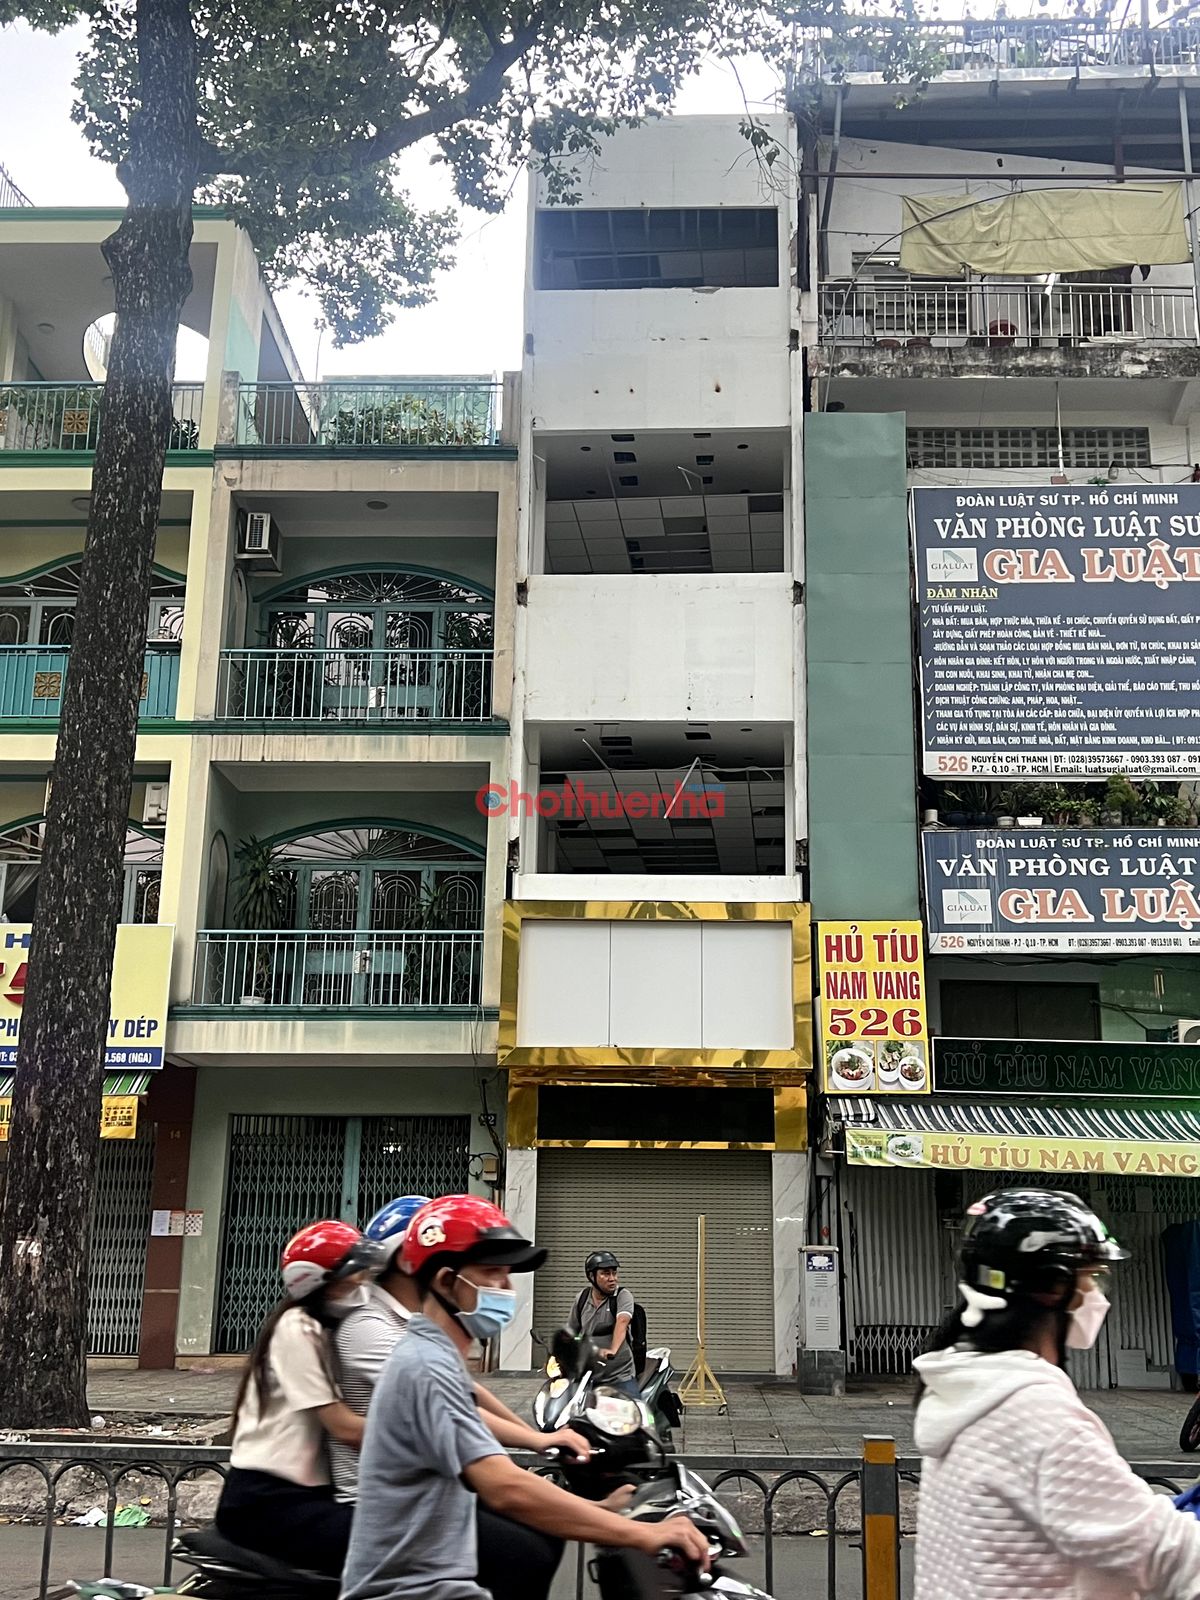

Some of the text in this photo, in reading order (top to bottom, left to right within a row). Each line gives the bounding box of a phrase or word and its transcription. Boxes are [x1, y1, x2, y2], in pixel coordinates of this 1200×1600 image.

[956, 490, 1179, 508] ĐOÀN LUẬT SƯ TP. HỒ CHÍ MINH
[934, 512, 987, 538] VĂN
[996, 511, 1086, 538] PHÒNG
[1093, 510, 1161, 542] LUẬT
[931, 562, 974, 570] GIALUAT
[983, 538, 1200, 590] GIA LUẬT
[926, 585, 998, 600] ĐẢM NHẬN
[931, 603, 988, 614] TƯ VẤN PHÁP LUẬT.
[1052, 670, 1064, 678] CHA
[1031, 683, 1041, 692] TY,
[936, 721, 948, 731] CÁC
[938, 756, 968, 771] 526
[1005, 754, 1019, 763] CHÍ
[1054, 765, 1196, 774] Email: luatsugialuat@gmail.com
[976, 837, 1016, 848] ĐOÀN
[1020, 836, 1057, 850] LUẬT
[1062, 837, 1081, 848] SƯ
[1085, 838, 1110, 848] TP.
[1113, 834, 1133, 848] HỒ
[1138, 836, 1162, 848] CHÍ
[937, 852, 1197, 880] VĂN PHÒNG LUẬT
[998, 878, 1200, 930] GIA LUẬ
[824, 925, 918, 963] HỦ TÍU
[940, 936, 965, 948] 526
[995, 939, 1011, 947] THANH
[826, 972, 920, 1000] NAM VANG
[124, 1015, 159, 1038] DÉP
[829, 1008, 922, 1036] 526
[128, 1052, 152, 1064] (NGA)
[943, 1042, 1200, 1090] HỦ TÍU NAM VAN
[930, 1137, 1199, 1174] HỦ TÍU NAM VANG
